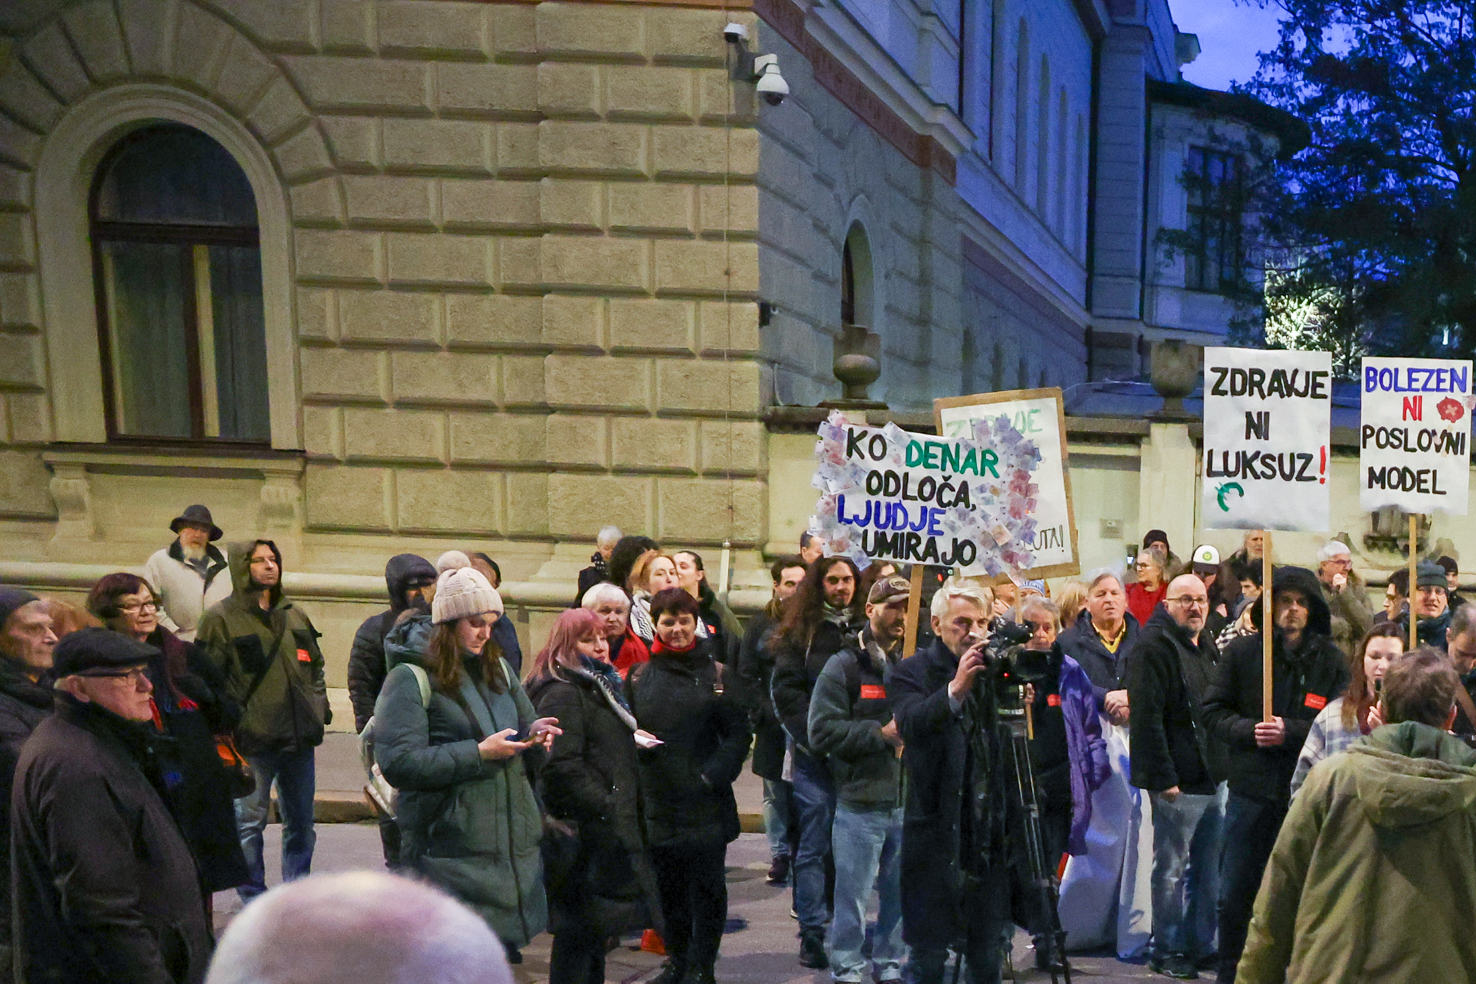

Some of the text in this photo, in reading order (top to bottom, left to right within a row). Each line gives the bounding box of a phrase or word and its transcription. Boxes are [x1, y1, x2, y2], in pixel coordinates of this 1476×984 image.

[1210, 367, 1329, 400] ZDRAVJE
[1365, 366, 1467, 393] BOLEZEN
[1402, 395, 1422, 421] NI
[1245, 411, 1270, 440] NI
[1362, 424, 1466, 455] POSLOVNI
[846, 427, 1000, 478] KO DENAR
[1206, 445, 1326, 484] LUKSUZ!
[865, 469, 977, 511] ODLOČA,
[1368, 466, 1447, 495] MODEL
[837, 494, 946, 536] LJUDJE
[861, 529, 977, 567] UMIRAJO
